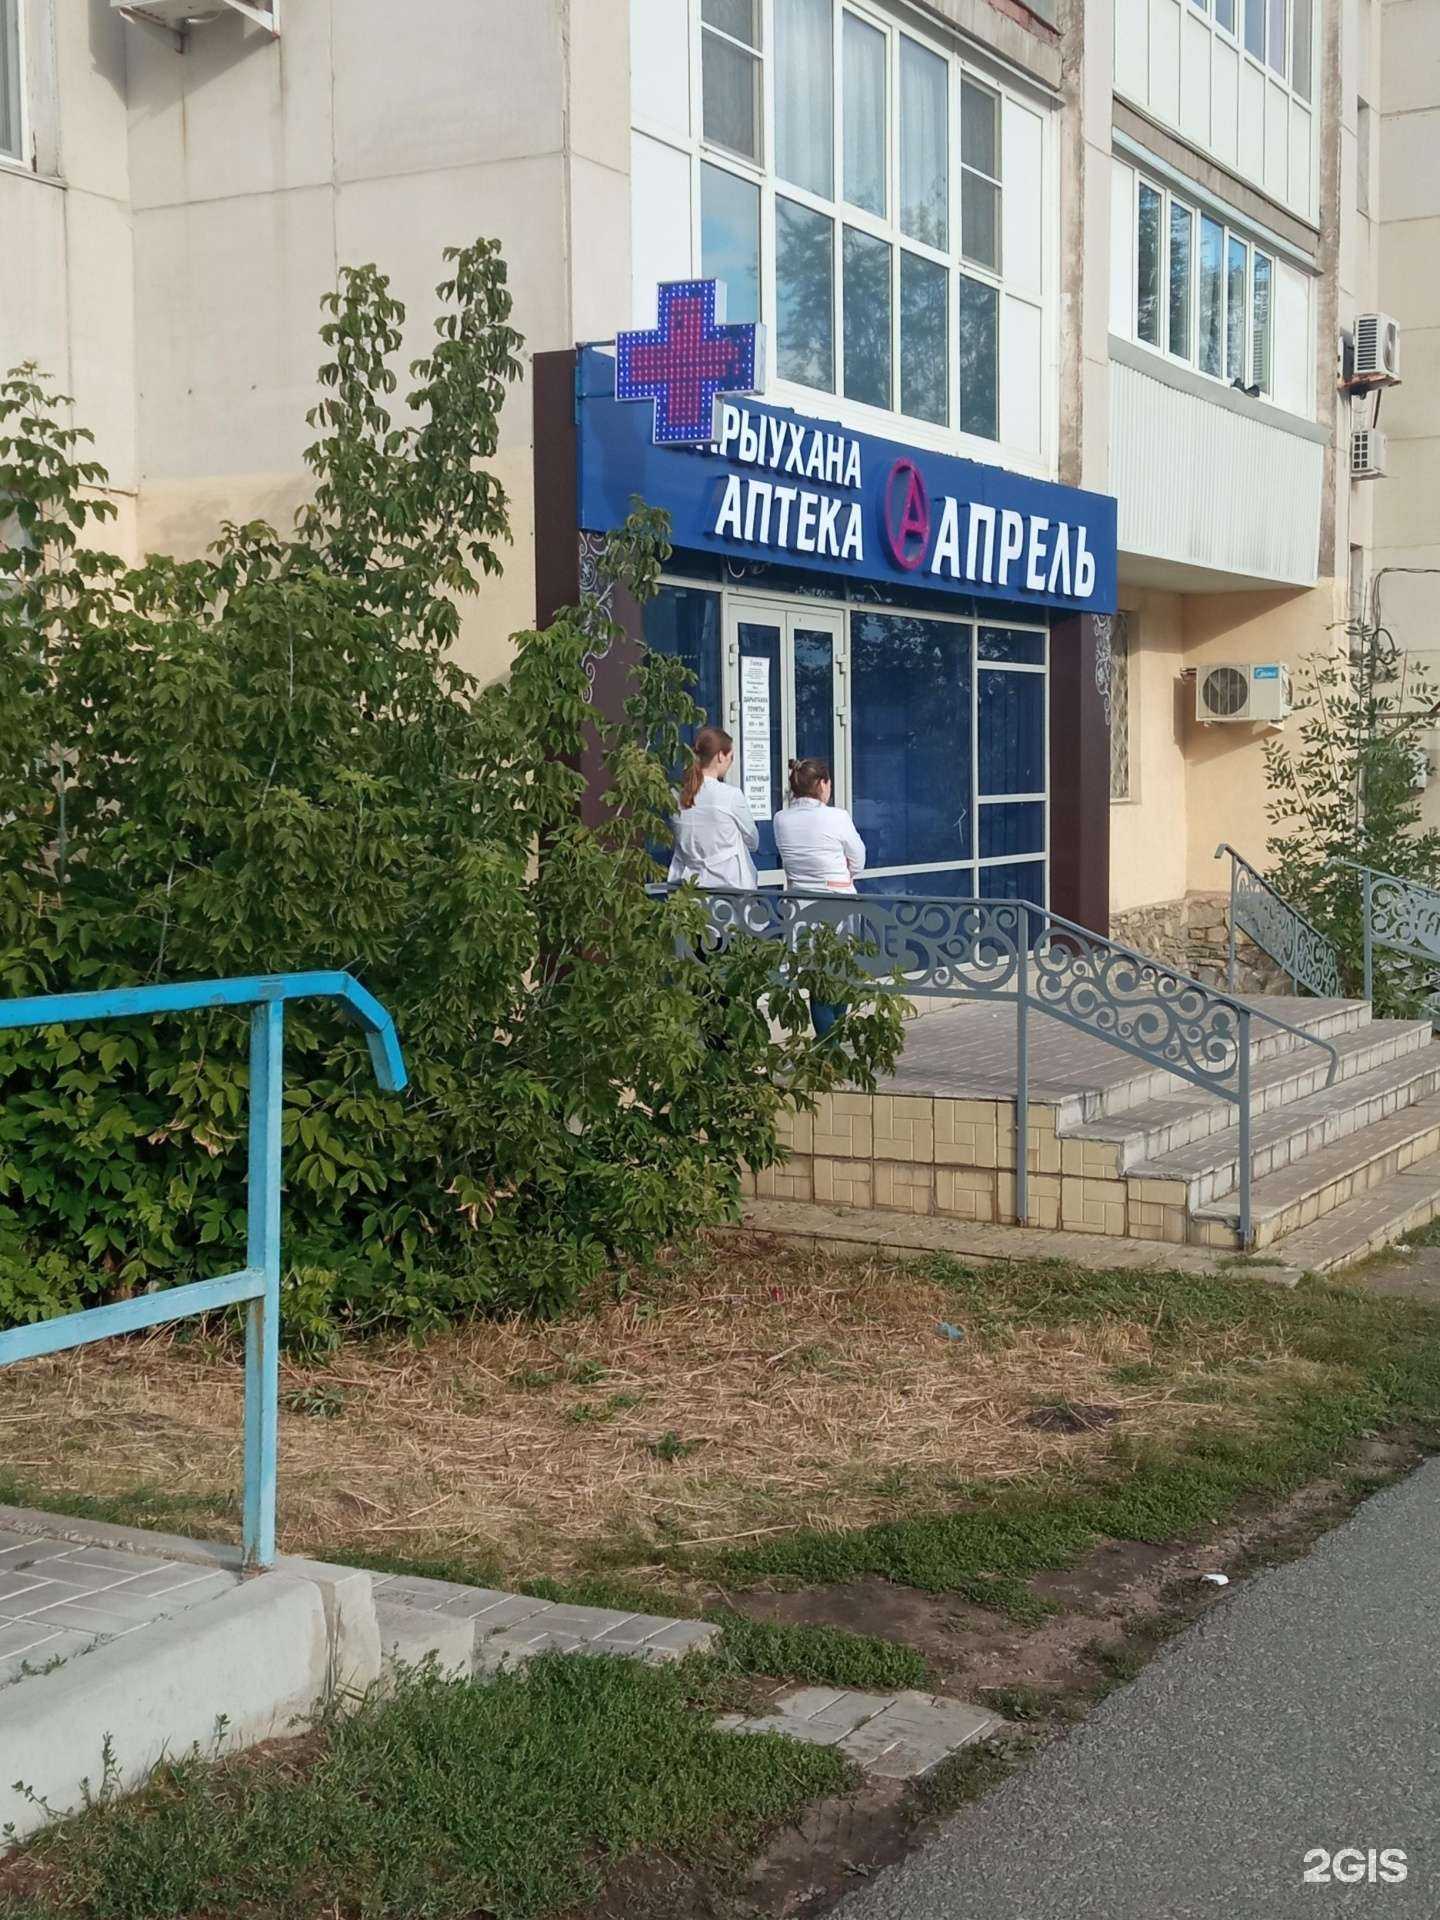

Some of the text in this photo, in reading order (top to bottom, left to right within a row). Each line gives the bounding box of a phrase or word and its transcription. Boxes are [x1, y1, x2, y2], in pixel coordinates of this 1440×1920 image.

[694, 403, 863, 488] РЫУХАНА
[714, 473, 864, 561] АПТЕКА
[930, 495, 1096, 598] АПРЕЛЬ
